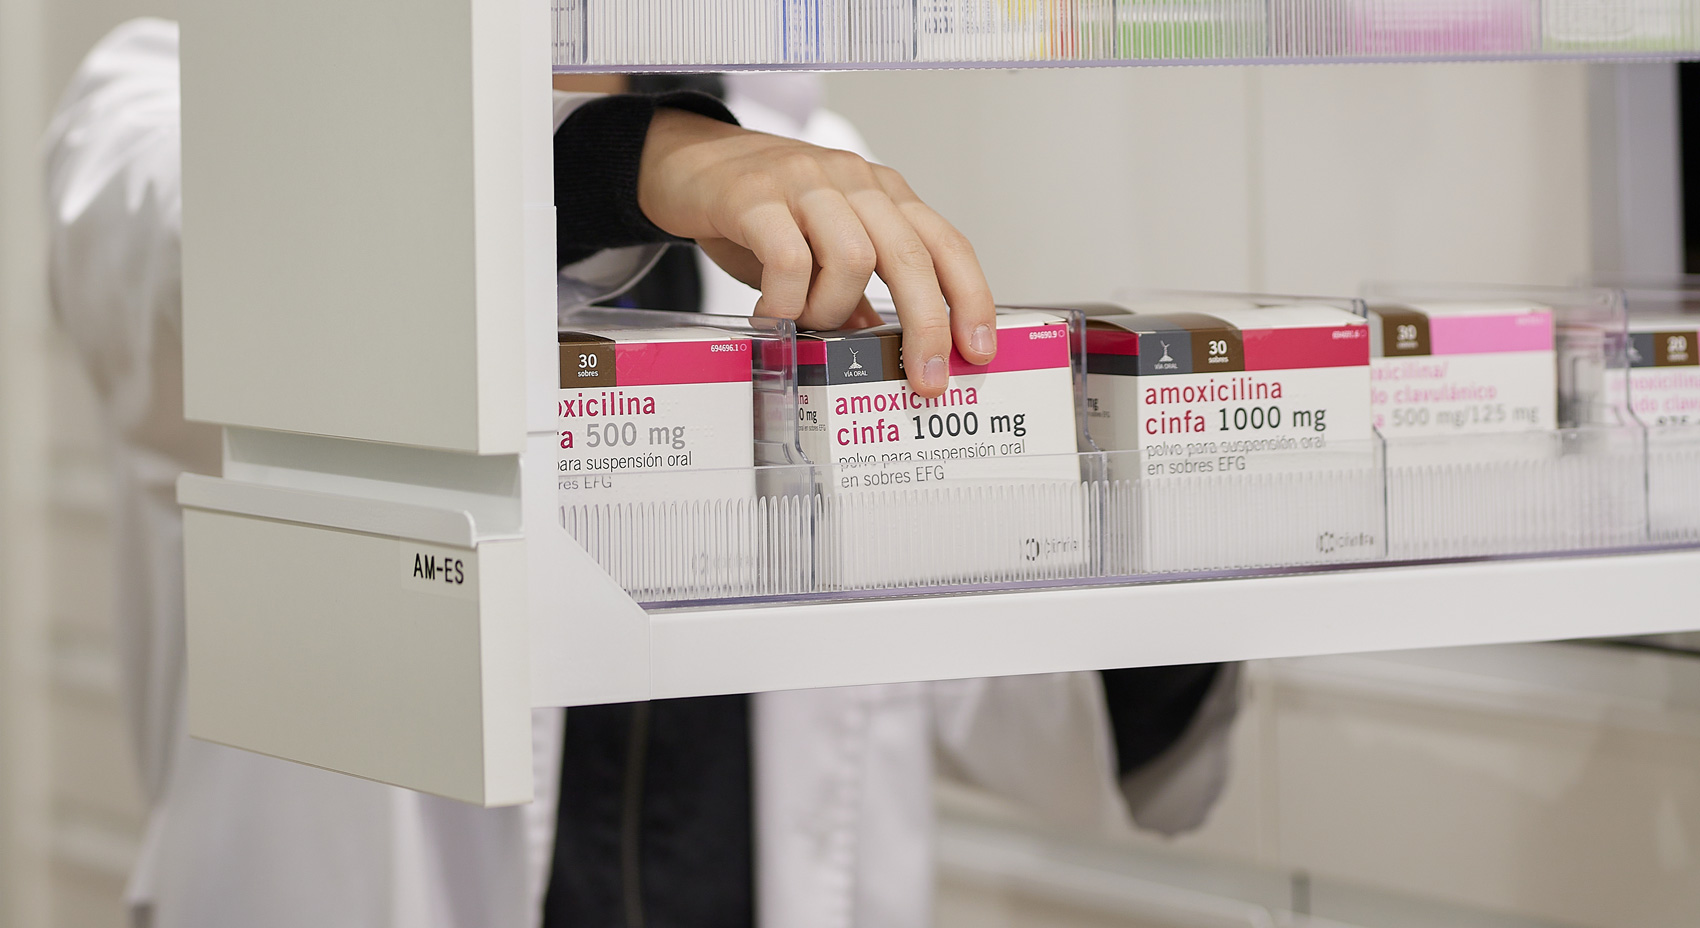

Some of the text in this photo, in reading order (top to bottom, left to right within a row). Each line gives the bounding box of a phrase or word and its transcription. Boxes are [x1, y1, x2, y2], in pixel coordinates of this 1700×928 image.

[578, 353, 597, 368] 30
[710, 343, 739, 353] 694696.1
[1208, 340, 1228, 355] 30
[577, 369, 599, 378] sobres
[844, 368, 868, 378] VÍA ORAL
[1145, 377, 1283, 405] amoxicilina
[558, 391, 656, 418] xicilina
[1392, 405, 1430, 428] 500
[1436, 402, 1507, 430] mg/125
[1512, 404, 1540, 425] mg
[837, 411, 1027, 447] cinfa 1000 mg
[1145, 406, 1327, 434] cinfa 1000 mg
[586, 421, 637, 448] 500
[649, 425, 686, 450] mg
[1146, 434, 1326, 460] polvo para suspensión oral
[586, 453, 663, 472] suspensión
[667, 451, 692, 467] oral
[838, 439, 1026, 472] polvo para suspensión oral
[1147, 456, 1246, 476] en sobres EFG
[841, 464, 945, 488] en sobres EFG
[413, 552, 464, 585] AM-ES
